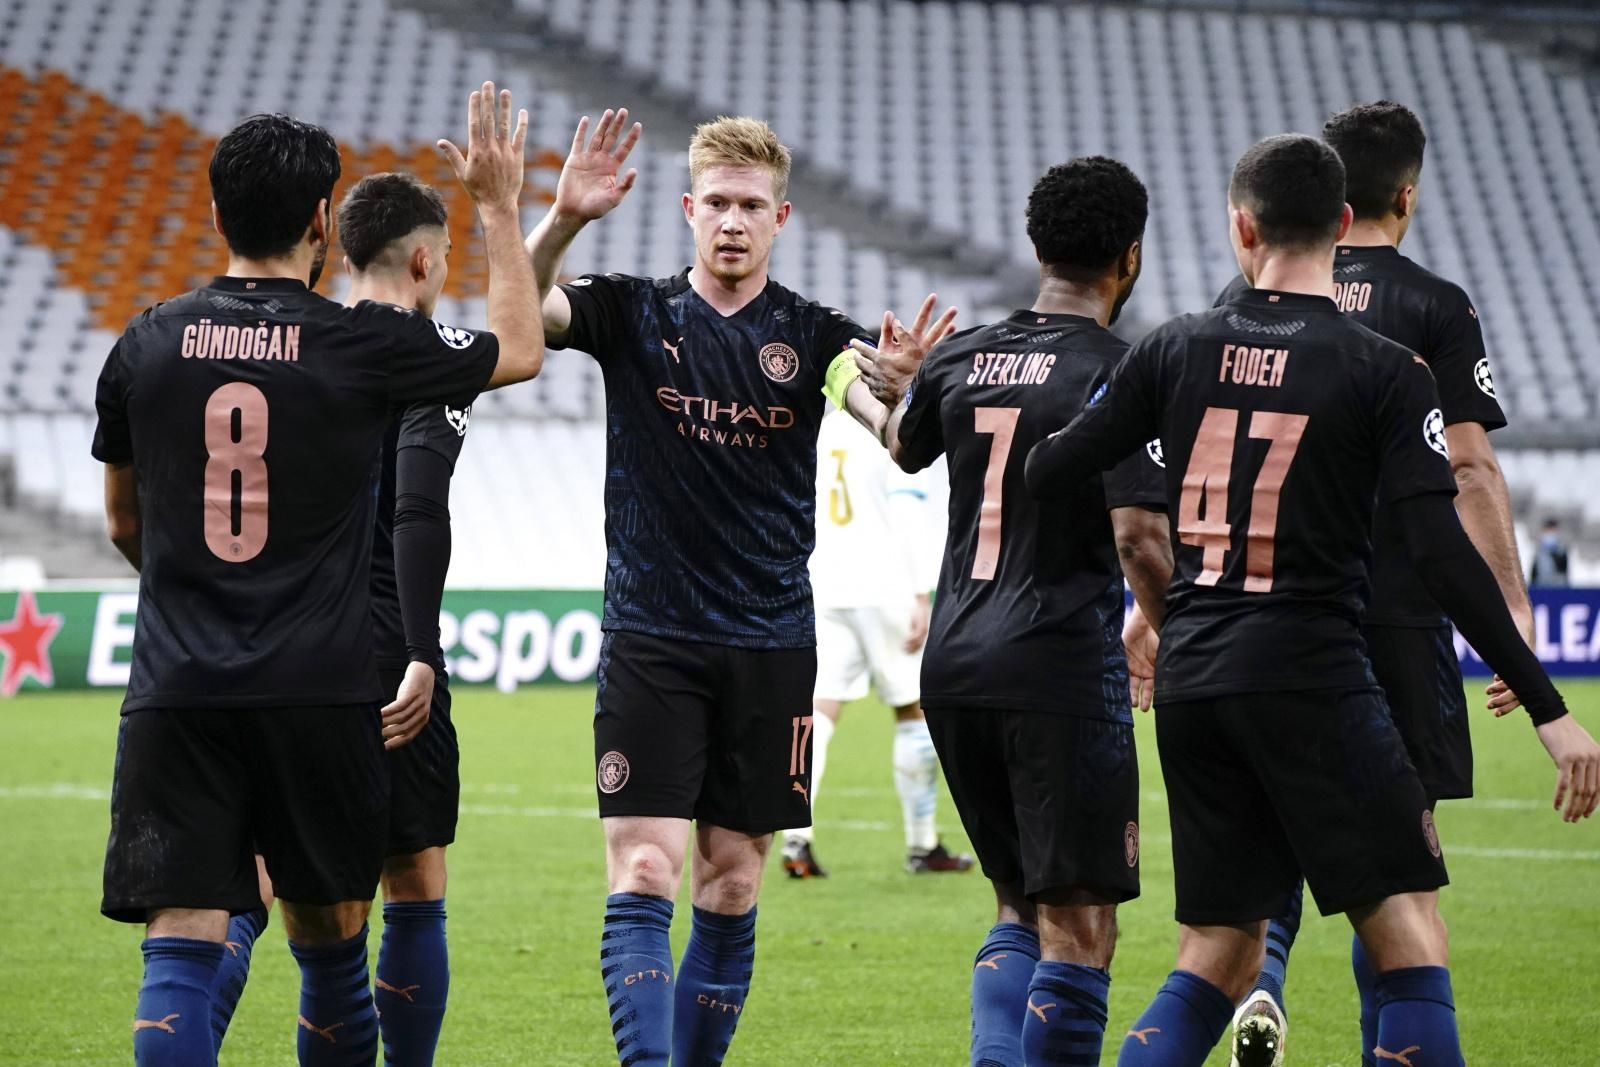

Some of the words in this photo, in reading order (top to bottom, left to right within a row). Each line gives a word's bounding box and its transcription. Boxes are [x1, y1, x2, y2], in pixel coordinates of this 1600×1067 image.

[181, 318, 301, 362] GÜNDOĞAN
[762, 345, 795, 360] MANCHESTER
[967, 352, 1057, 385] STERLING
[1219, 344, 1289, 388] FODEN
[656, 386, 795, 429] ETIHAD
[677, 421, 769, 449] AIRWAYS
[204, 381, 269, 563] 8
[829, 449, 854, 526] 3
[971, 406, 1022, 581] 7
[1178, 406, 1310, 593] 47
[789, 715, 814, 776] 17
[624, 969, 670, 986] CITY
[697, 994, 741, 1016] CITY
